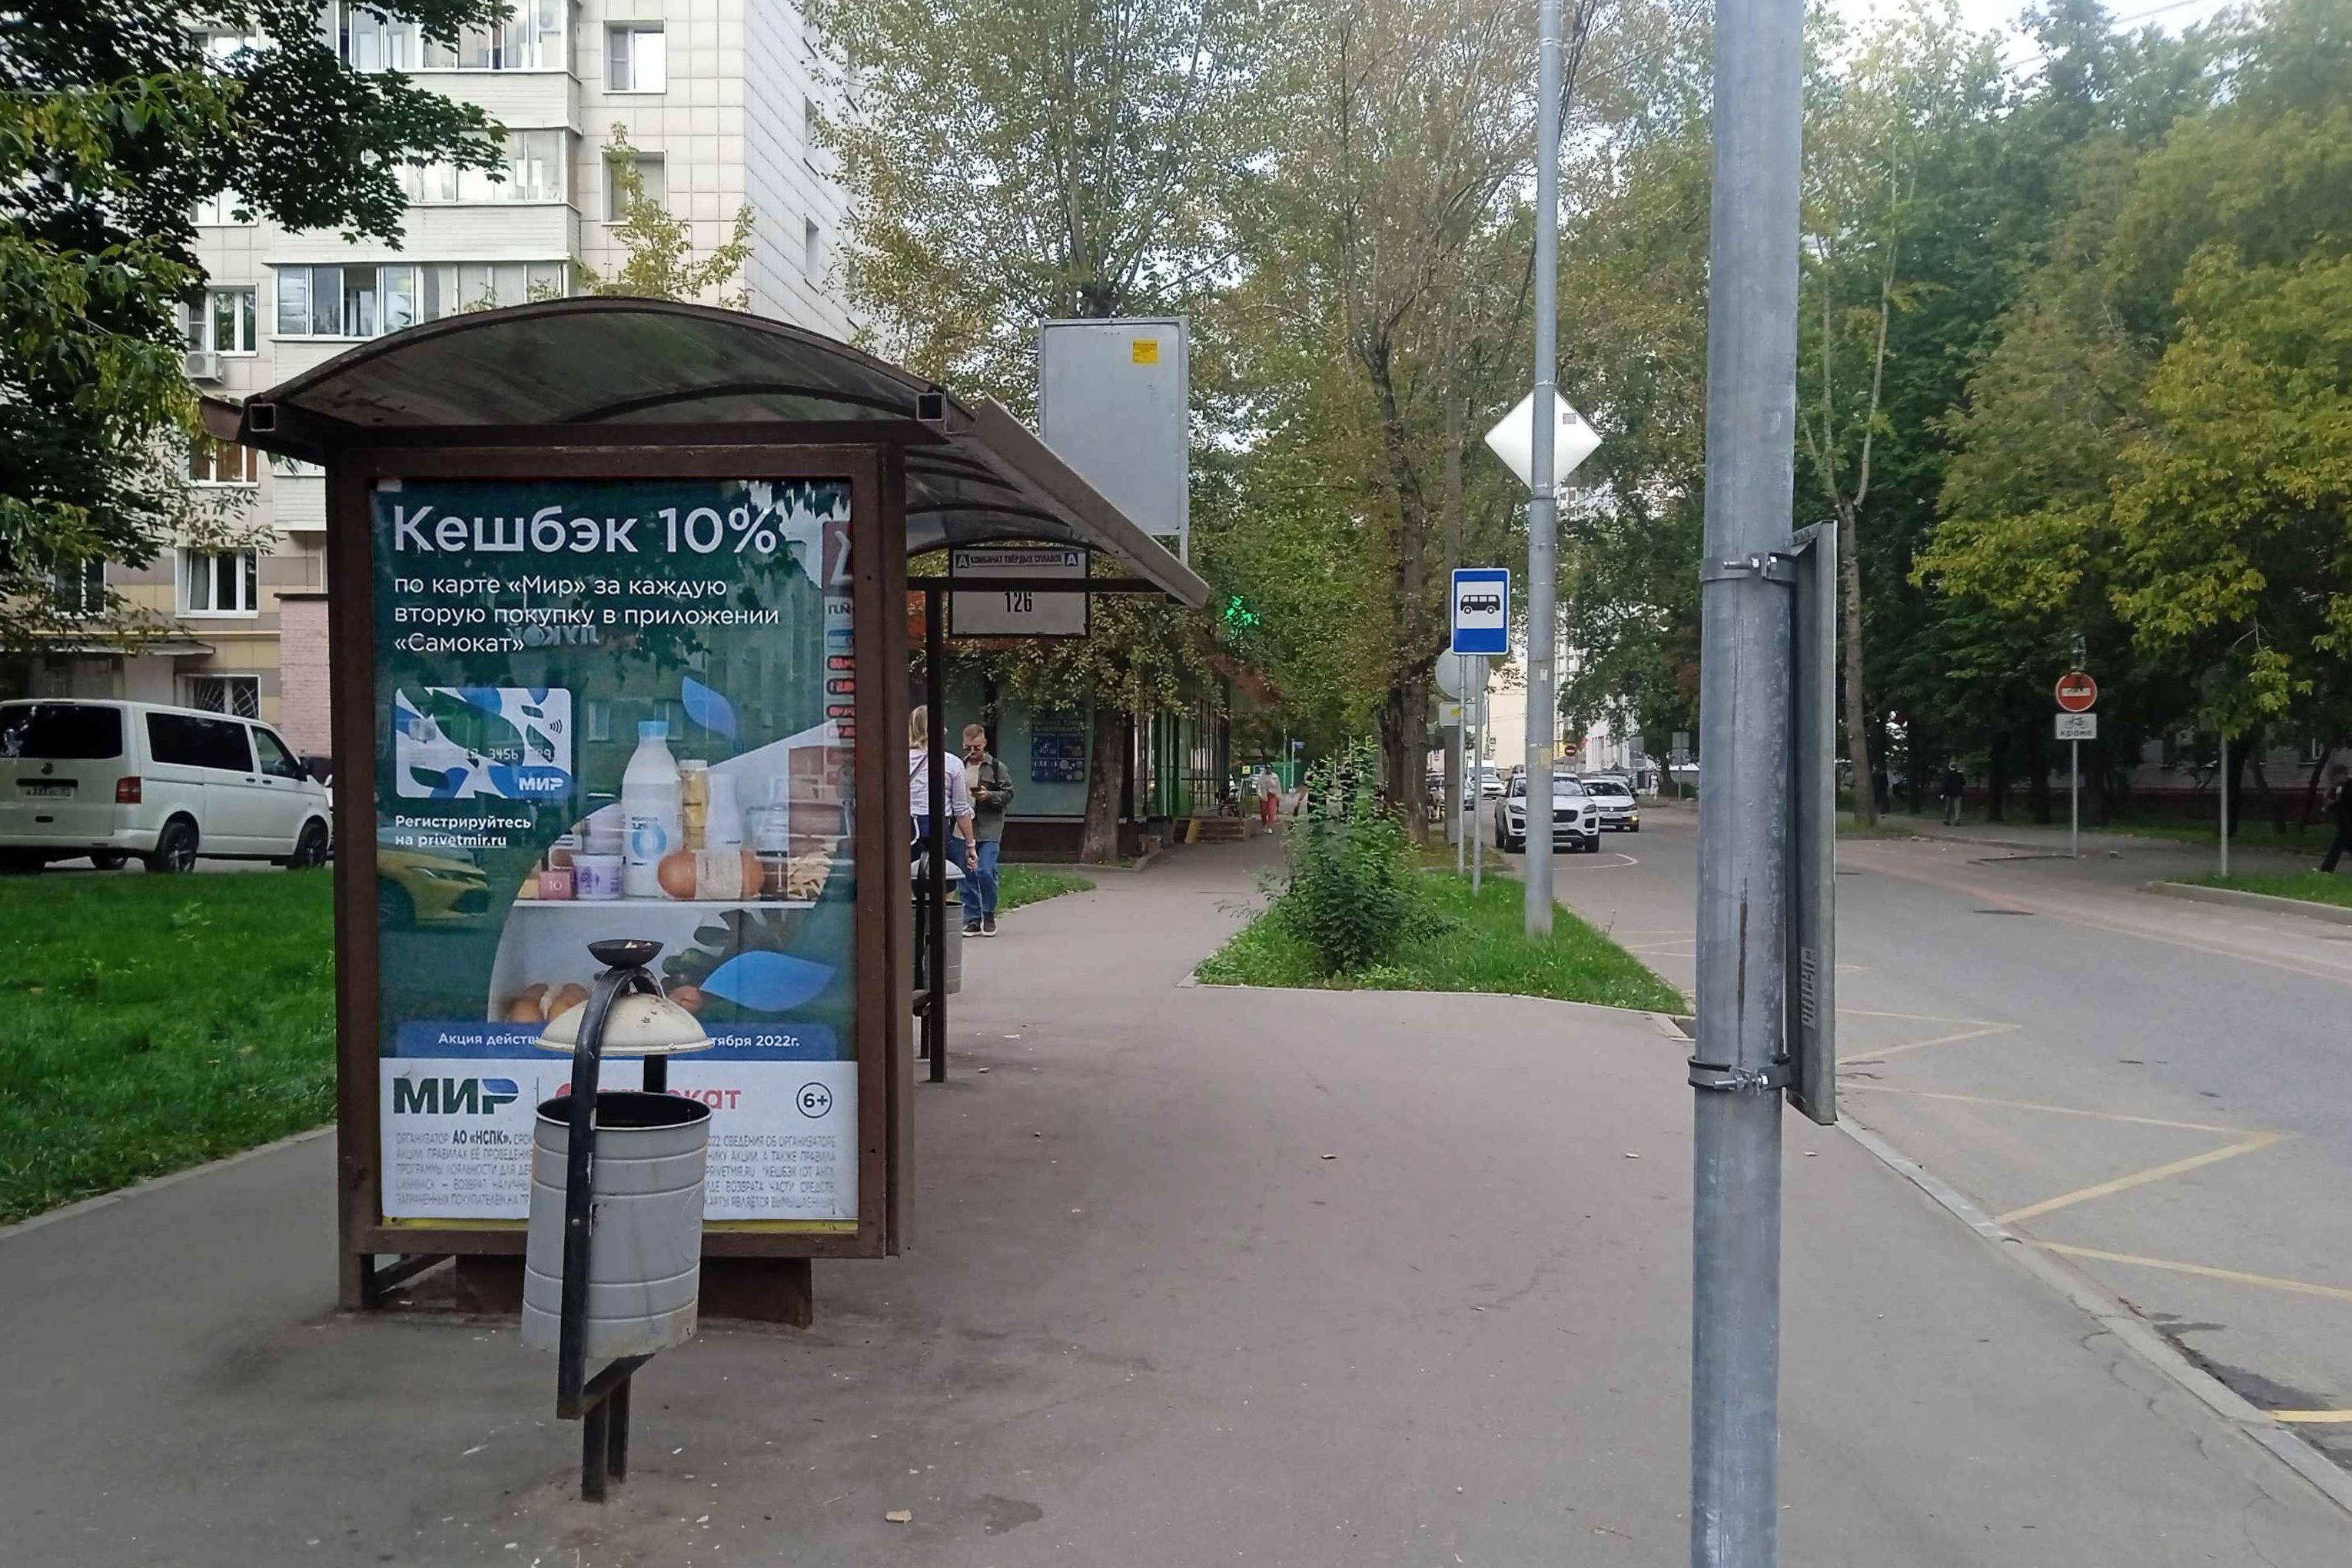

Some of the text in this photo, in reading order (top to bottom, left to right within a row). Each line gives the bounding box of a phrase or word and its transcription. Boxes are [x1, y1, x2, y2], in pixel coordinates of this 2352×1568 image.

[394, 505, 777, 553] Кешбэк 10%
[394, 575, 727, 598] по карте «Мир» за каждую
[1005, 592, 1033, 613] 126
[394, 606, 779, 627] вторую покупку в приложении
[394, 633, 525, 653] «Самокат»
[488, 748, 519, 760] 3456
[519, 777, 564, 791] МИР
[395, 815, 532, 831] Регистрируйтесь
[395, 833, 507, 849] на privetmir.ru
[549, 879, 563, 892] 10
[438, 1033, 540, 1046] Акция действ
[710, 1035, 800, 1048] тября 2022г.
[393, 1078, 520, 1115] МИР
[803, 1092, 829, 1108] 6+
[452, 1129, 467, 1144] АО
